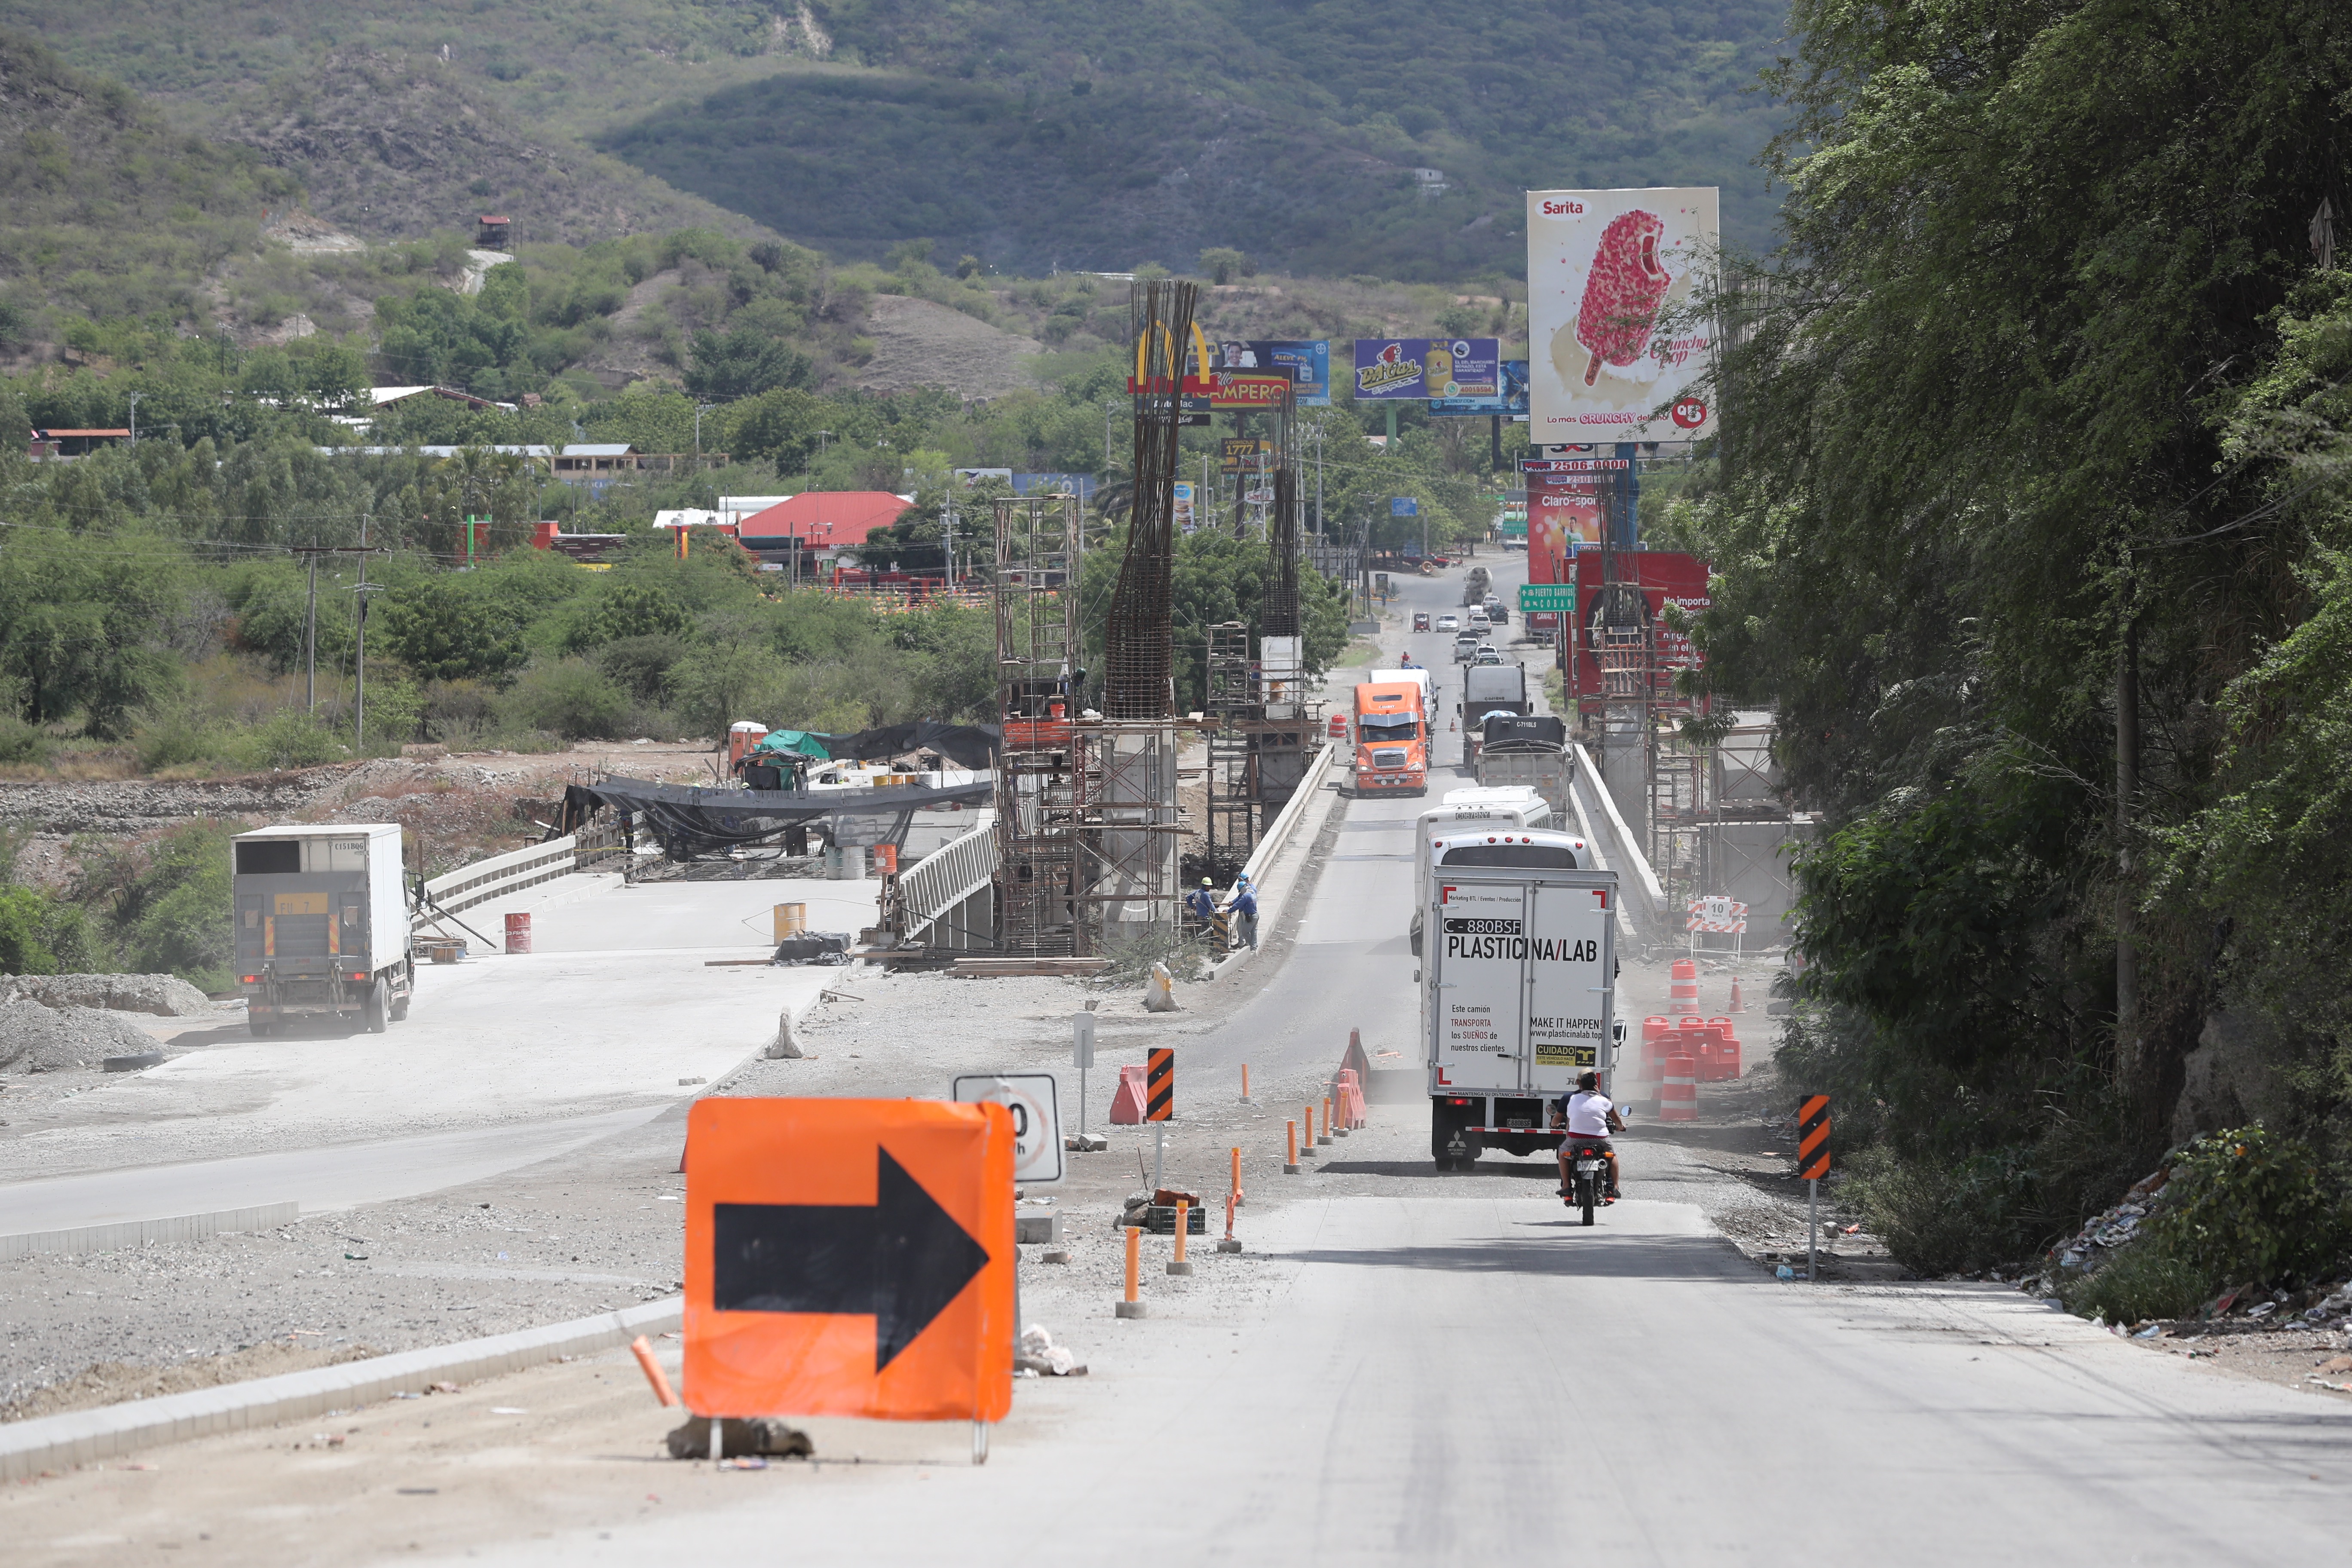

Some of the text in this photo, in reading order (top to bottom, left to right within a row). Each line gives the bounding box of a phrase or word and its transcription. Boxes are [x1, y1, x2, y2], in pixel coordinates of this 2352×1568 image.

[1544, 201, 1583, 214] Sarita
[1579, 412, 1635, 425] CRUNCHY
[1226, 444, 1254, 455] 1777
[1535, 587, 1573, 597] PUERTO BARRIOS
[1677, 595, 1710, 607] importa
[1456, 812, 1488, 820] C067BNY
[280, 903, 293, 914] FU
[1712, 903, 1724, 913] 10
[1445, 919, 1454, 932] C
[1467, 920, 1520, 934] 880BSF
[1449, 936, 1597, 962] PLASTICINA/LAB
[1452, 1004, 1490, 1013] Este camión
[1451, 1019, 1491, 1027] TRANSPORTA
[1531, 1017, 1602, 1030] MAKE IT HAPPEN!
[1452, 1031, 1461, 1039] los
[1463, 1029, 1488, 1039] SUEÑOS
[1530, 1029, 1602, 1041] www.plasticinalab.top
[1480, 1044, 1505, 1052] clientes
[1537, 1046, 1574, 1055] CUIDADO
[1009, 1103, 1028, 1137] 0
